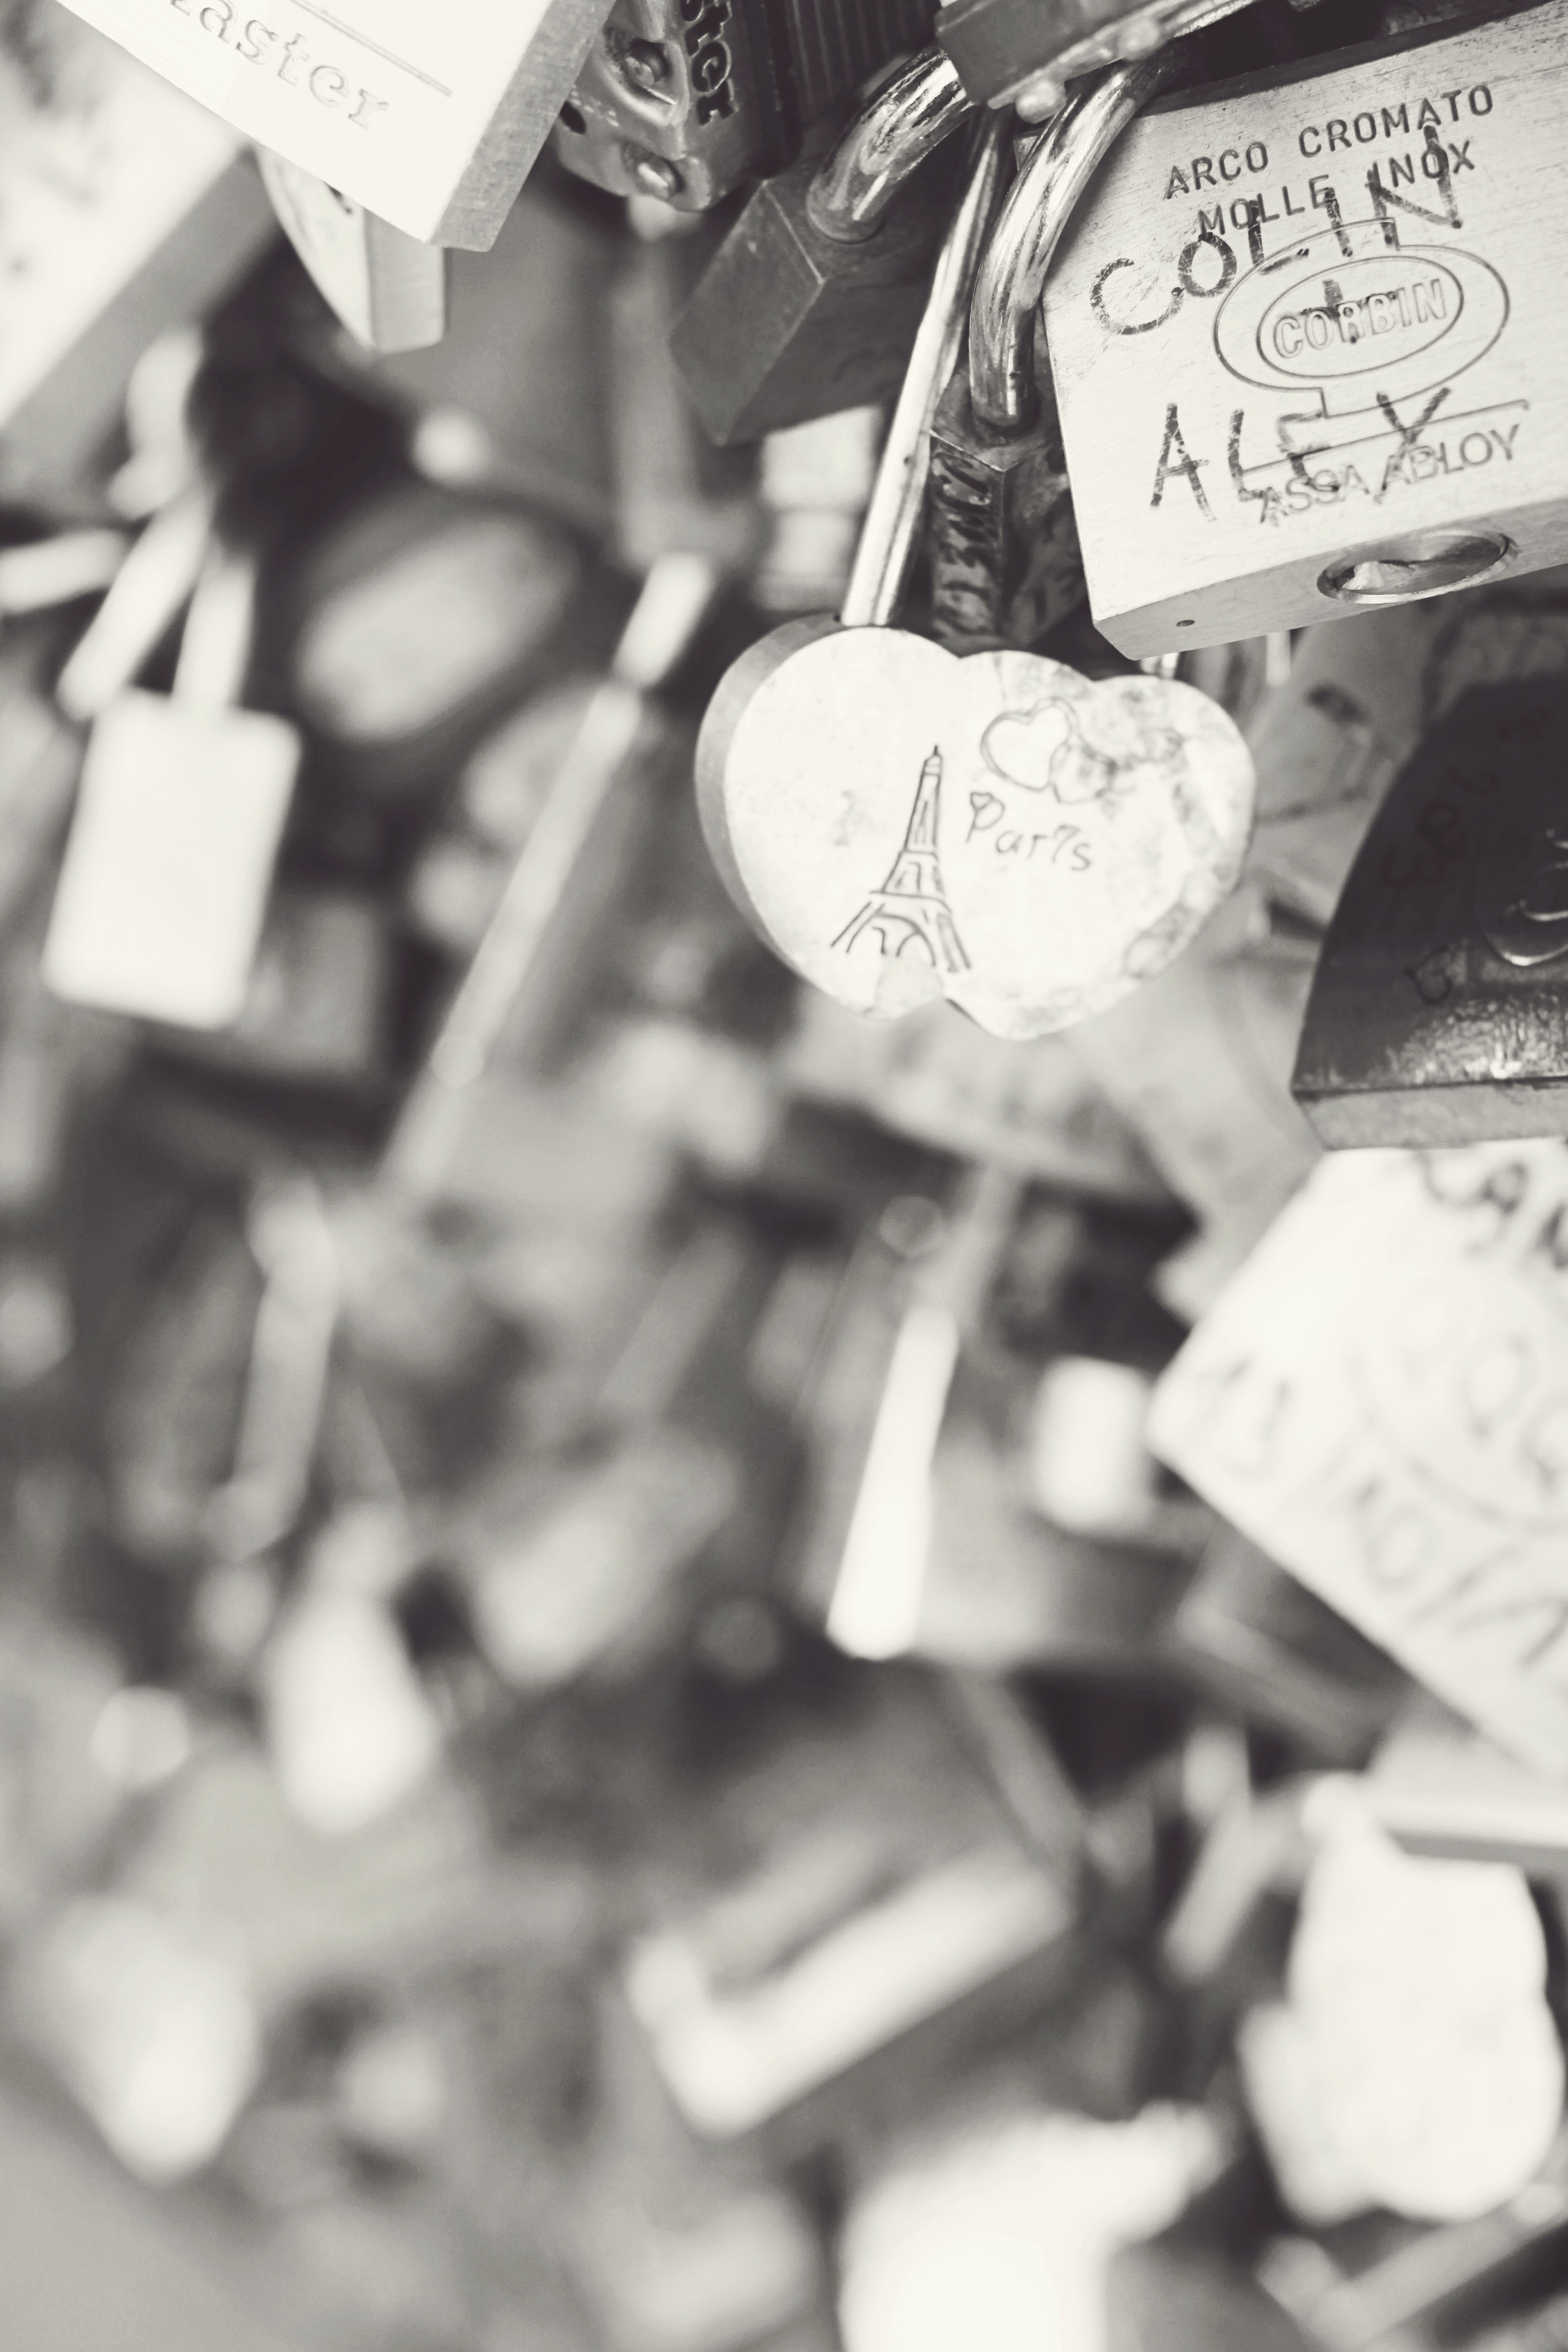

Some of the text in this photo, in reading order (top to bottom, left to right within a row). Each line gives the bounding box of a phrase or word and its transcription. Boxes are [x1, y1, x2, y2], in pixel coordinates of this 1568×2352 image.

[1163, 84, 1494, 199] ARCO CROMATO
[1197, 140, 1475, 236] MOLLE INOX
[1090, 125, 1462, 336] COLIN
[1273, 279, 1447, 359] CORBIN
[1149, 387, 1451, 523] ALEX
[1258, 424, 1520, 524] ASSA ABLOY
